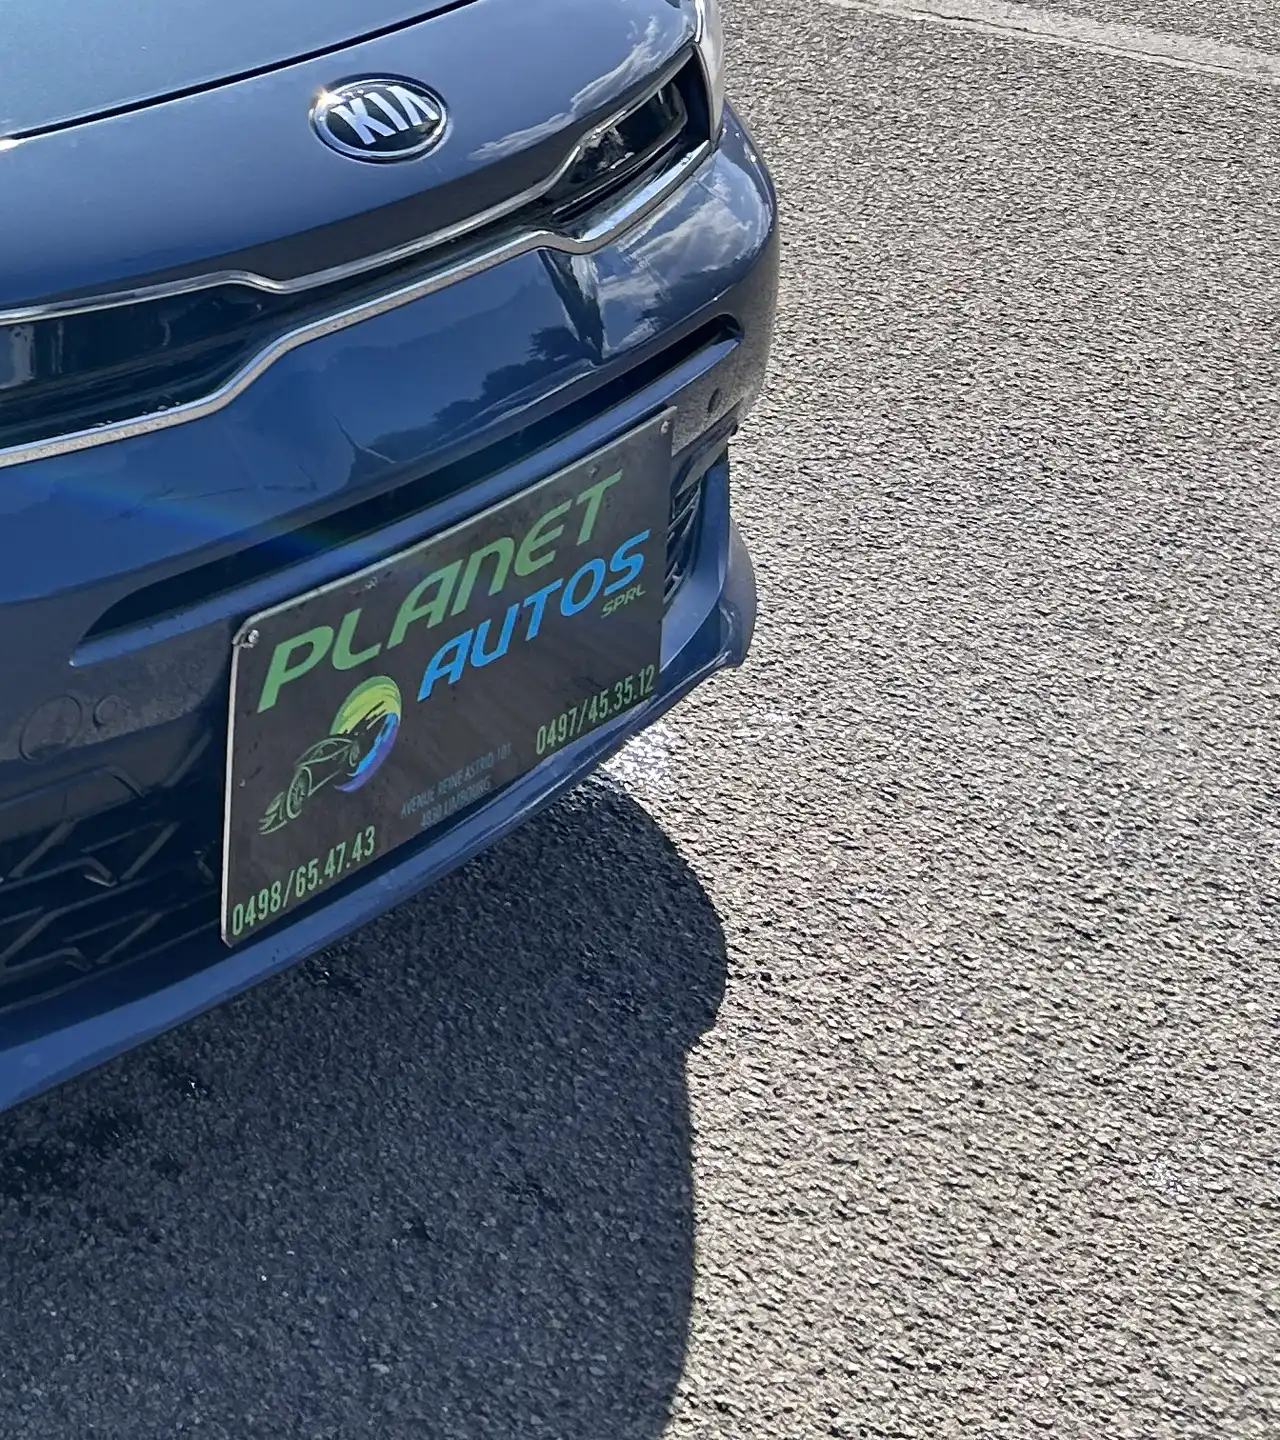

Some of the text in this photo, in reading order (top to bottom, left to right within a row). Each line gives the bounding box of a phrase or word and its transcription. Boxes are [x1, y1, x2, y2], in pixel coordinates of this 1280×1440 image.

[330, 85, 440, 145] KIA
[257, 469, 623, 713] PLANET
[417, 529, 651, 702] AUTOS
[600, 584, 646, 619] SPRL
[536, 664, 655, 754] 0497/45.35.12
[232, 825, 376, 936] 0498/65.47.43
